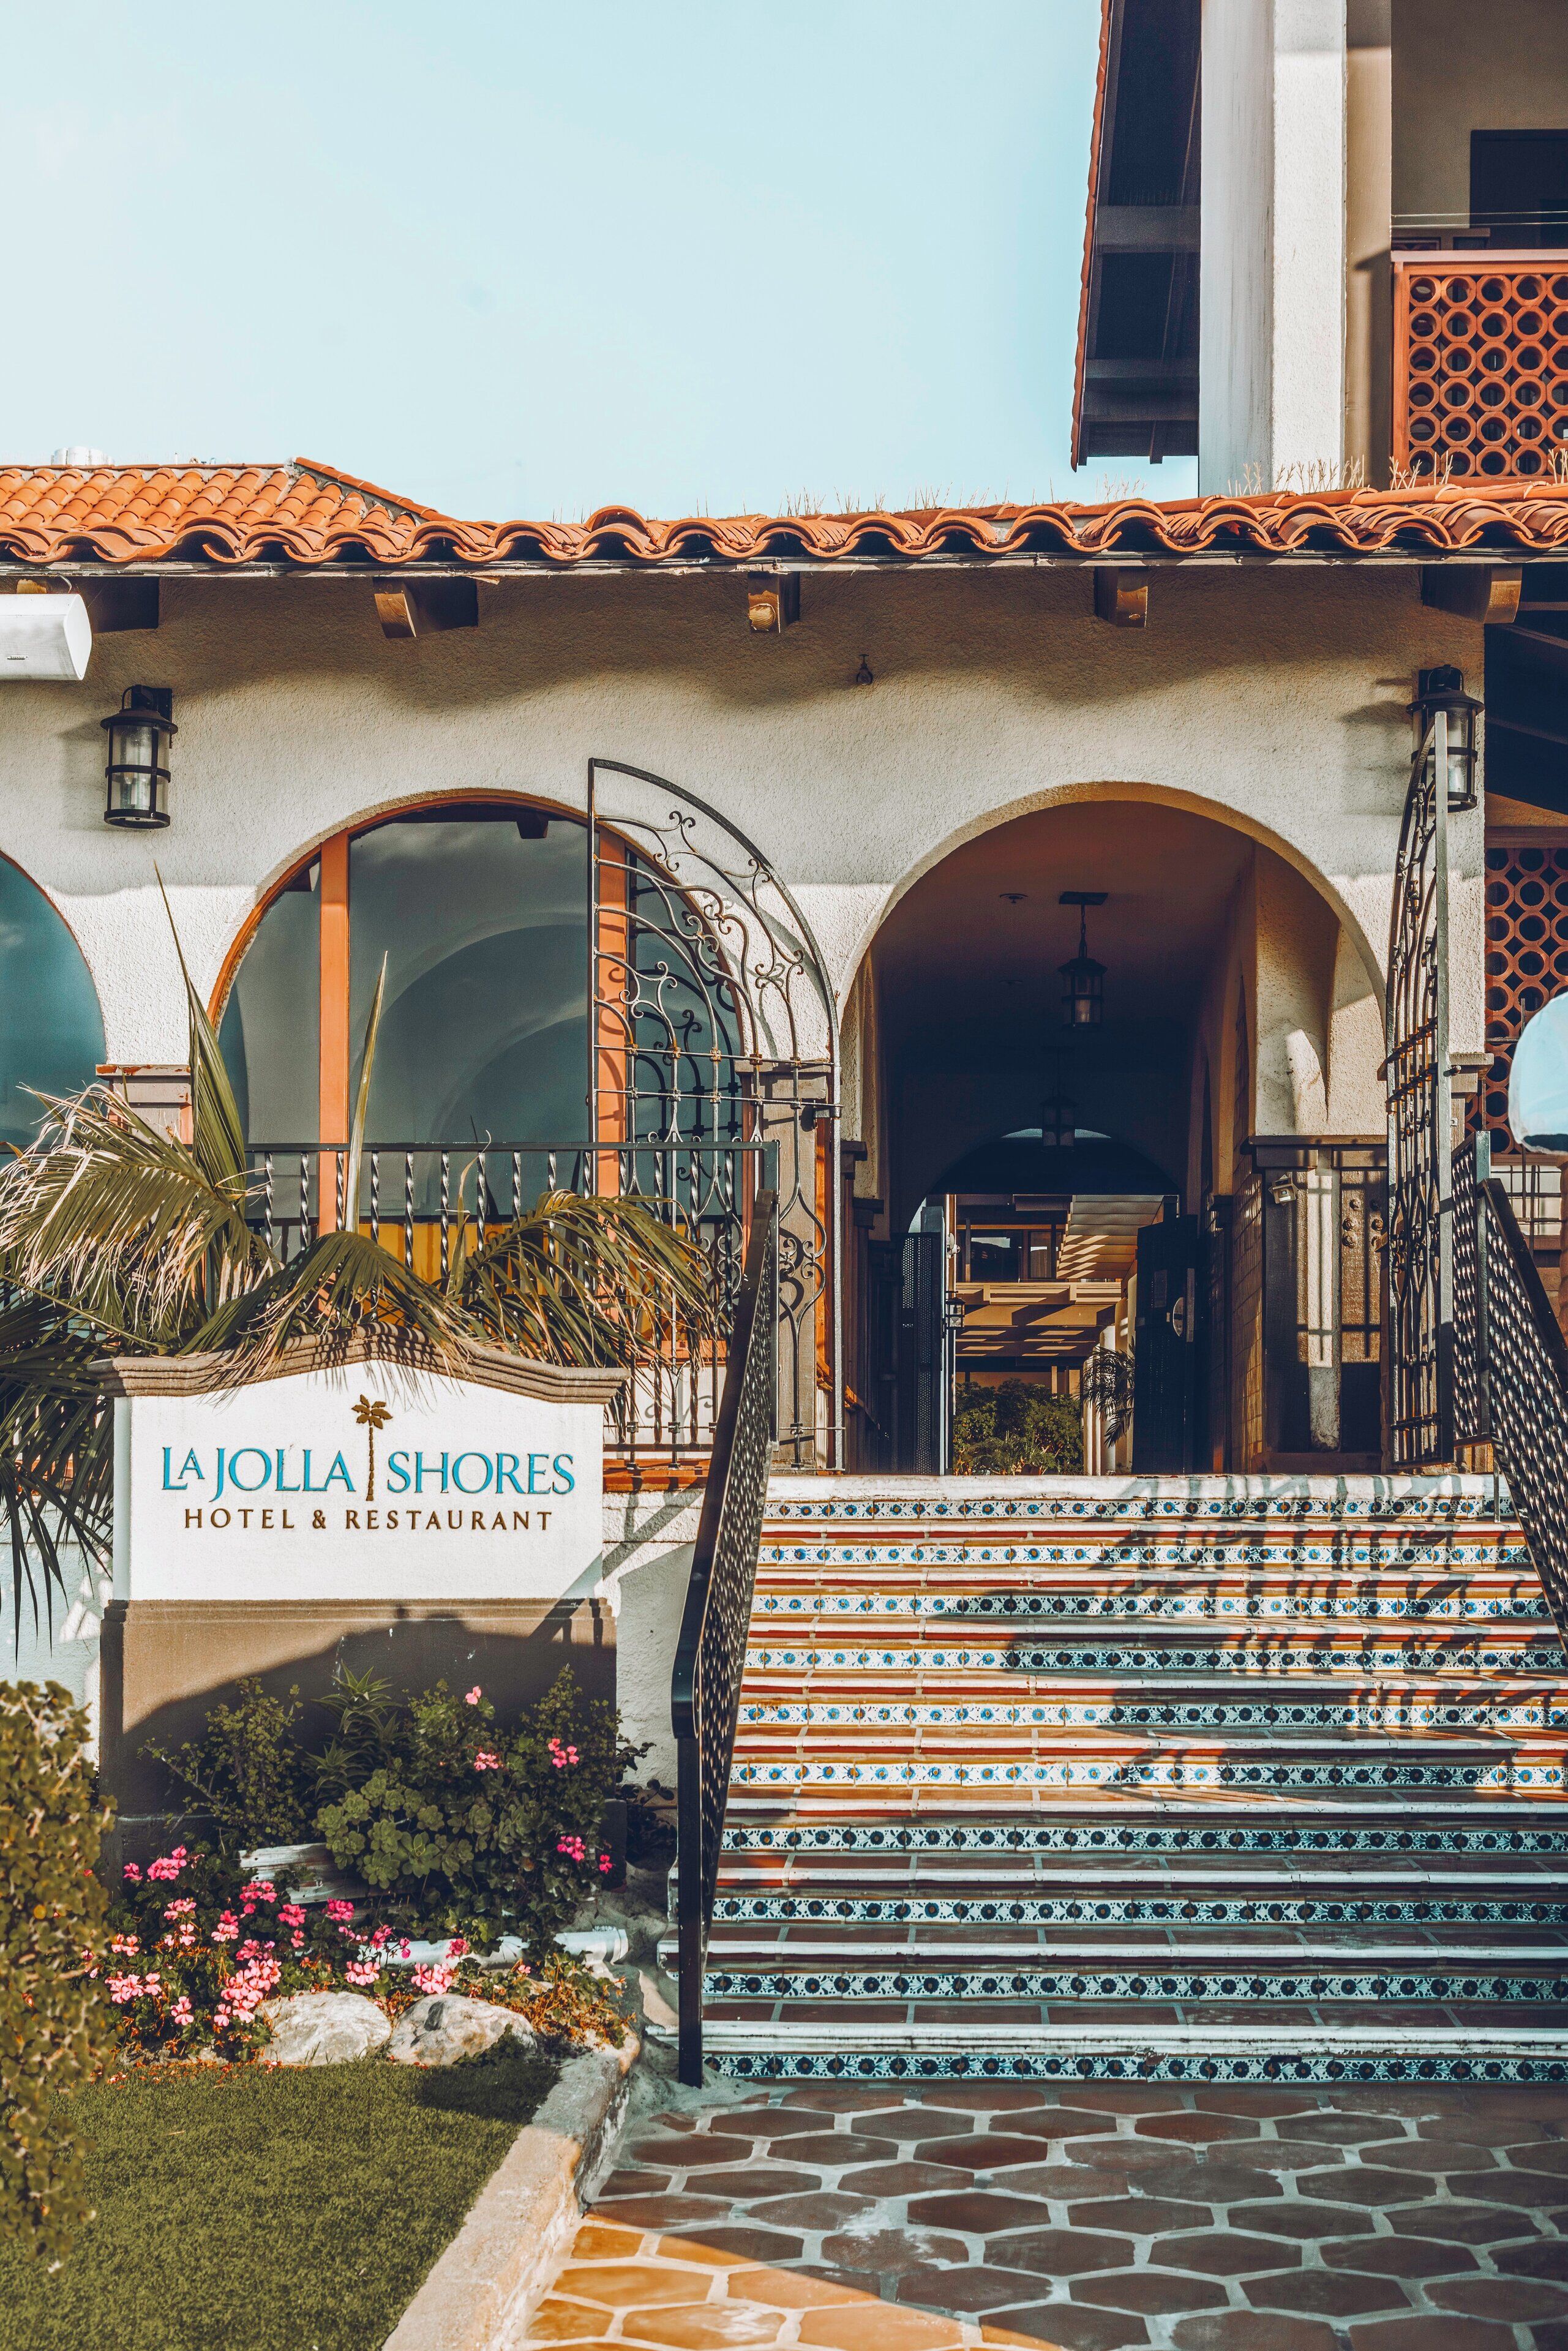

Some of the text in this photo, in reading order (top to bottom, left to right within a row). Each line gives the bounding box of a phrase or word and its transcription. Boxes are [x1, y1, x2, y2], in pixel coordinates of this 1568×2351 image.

[162, 1447, 575, 1502] LA JOLLA SHORES
[184, 1508, 552, 1531] HOTEL & RESTAURANT
